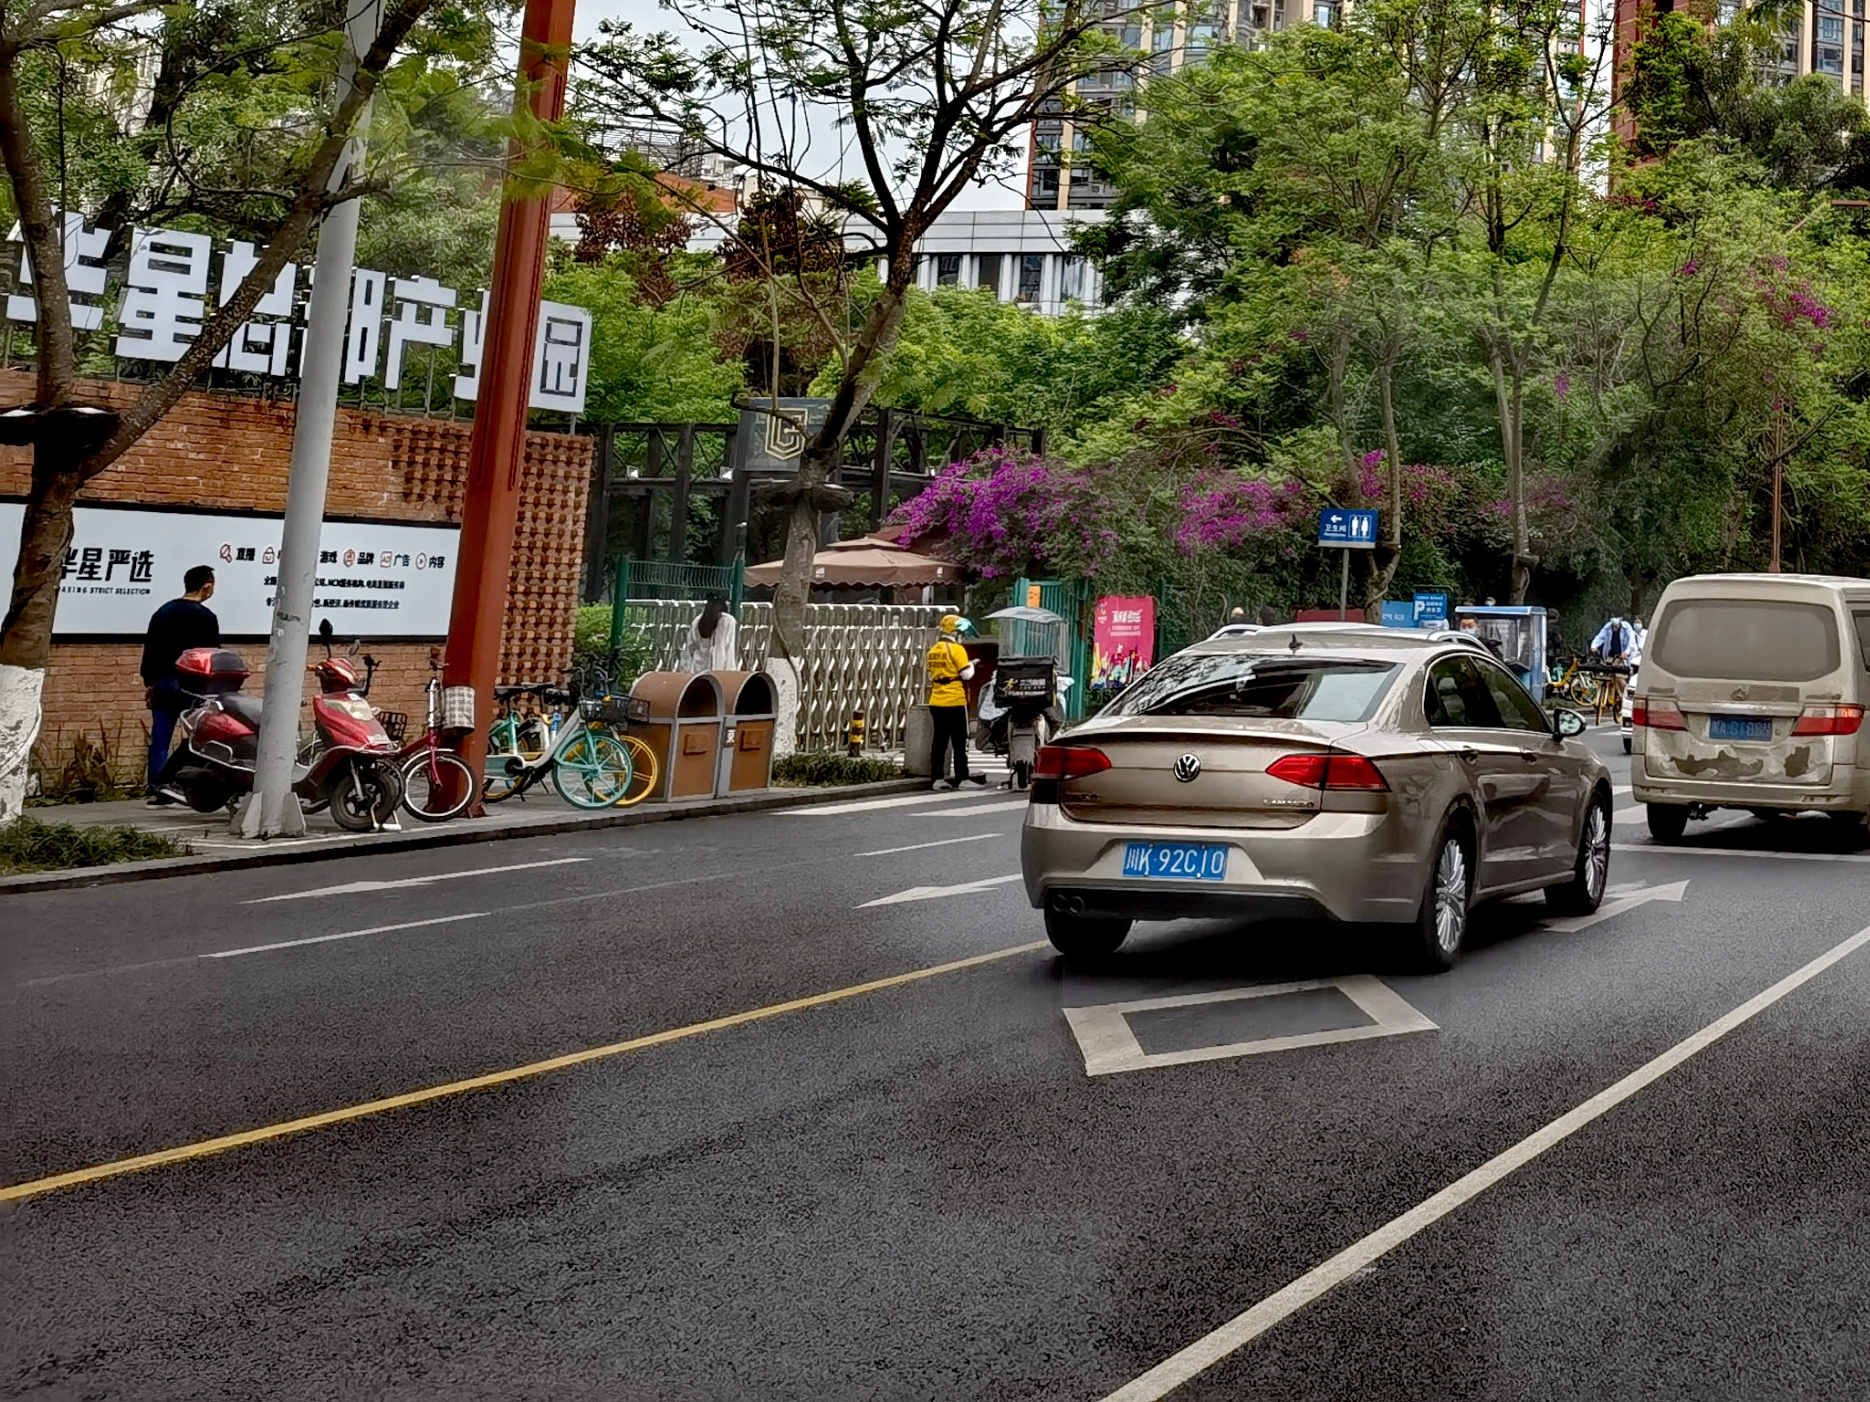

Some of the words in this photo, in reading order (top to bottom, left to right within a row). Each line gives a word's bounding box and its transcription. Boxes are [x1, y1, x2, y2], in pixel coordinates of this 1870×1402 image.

[236, 547, 256, 561] 直播
[393, 554, 411, 567] 广告
[428, 555, 445, 569] 内容
